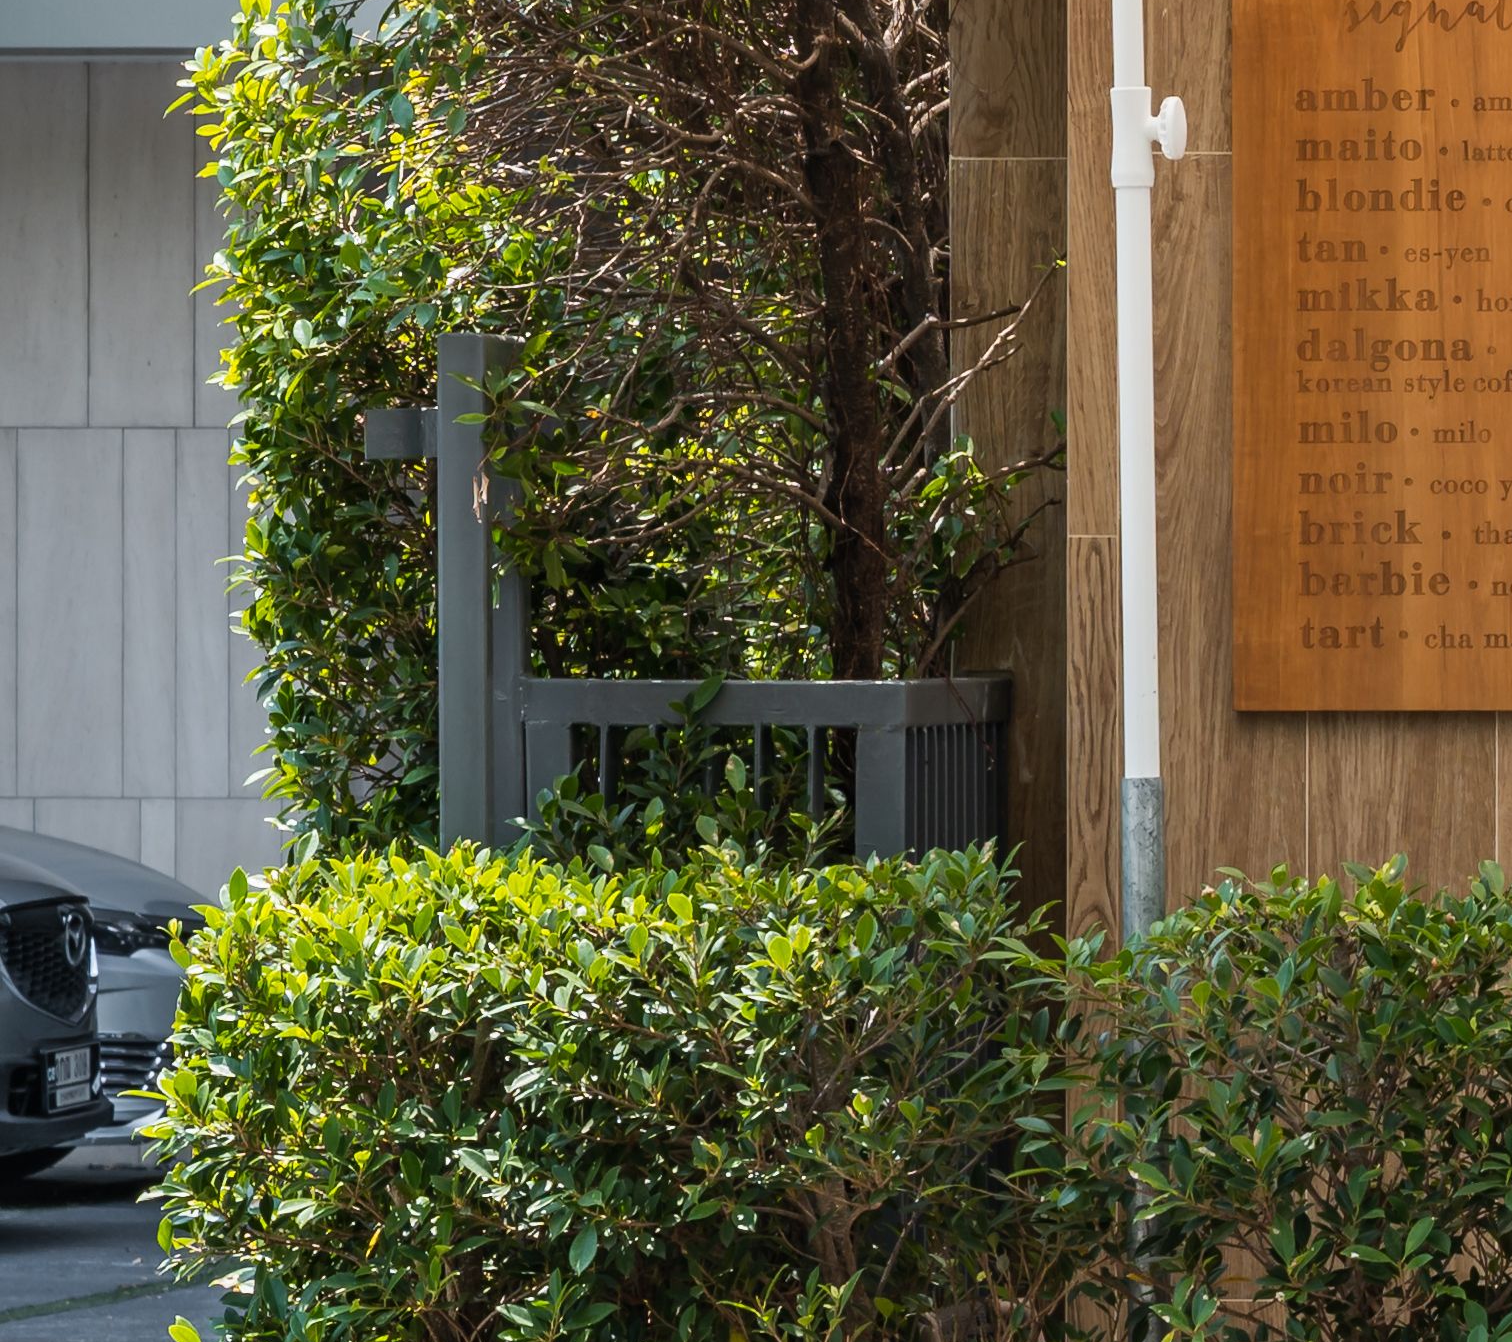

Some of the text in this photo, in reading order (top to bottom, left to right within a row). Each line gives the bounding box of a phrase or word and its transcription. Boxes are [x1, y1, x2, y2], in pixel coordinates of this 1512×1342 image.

[1294, 77, 1436, 112] amber
[1295, 128, 1423, 161] maito
[1295, 177, 1468, 212] blondie
[1296, 230, 1492, 270] tan es-yen
[1296, 277, 1439, 312] mikka
[1295, 327, 1475, 373] dalgona
[1296, 369, 1393, 394] korean
[1403, 369, 1467, 401] style
[1297, 410, 1493, 445] milo milo
[1297, 461, 1394, 495] noir
[1429, 477, 1489, 495] coco
[1297, 509, 1424, 546] brick
[1297, 560, 1452, 597] barbie
[1298, 615, 1386, 650] tart
[1423, 623, 1474, 650] cha
